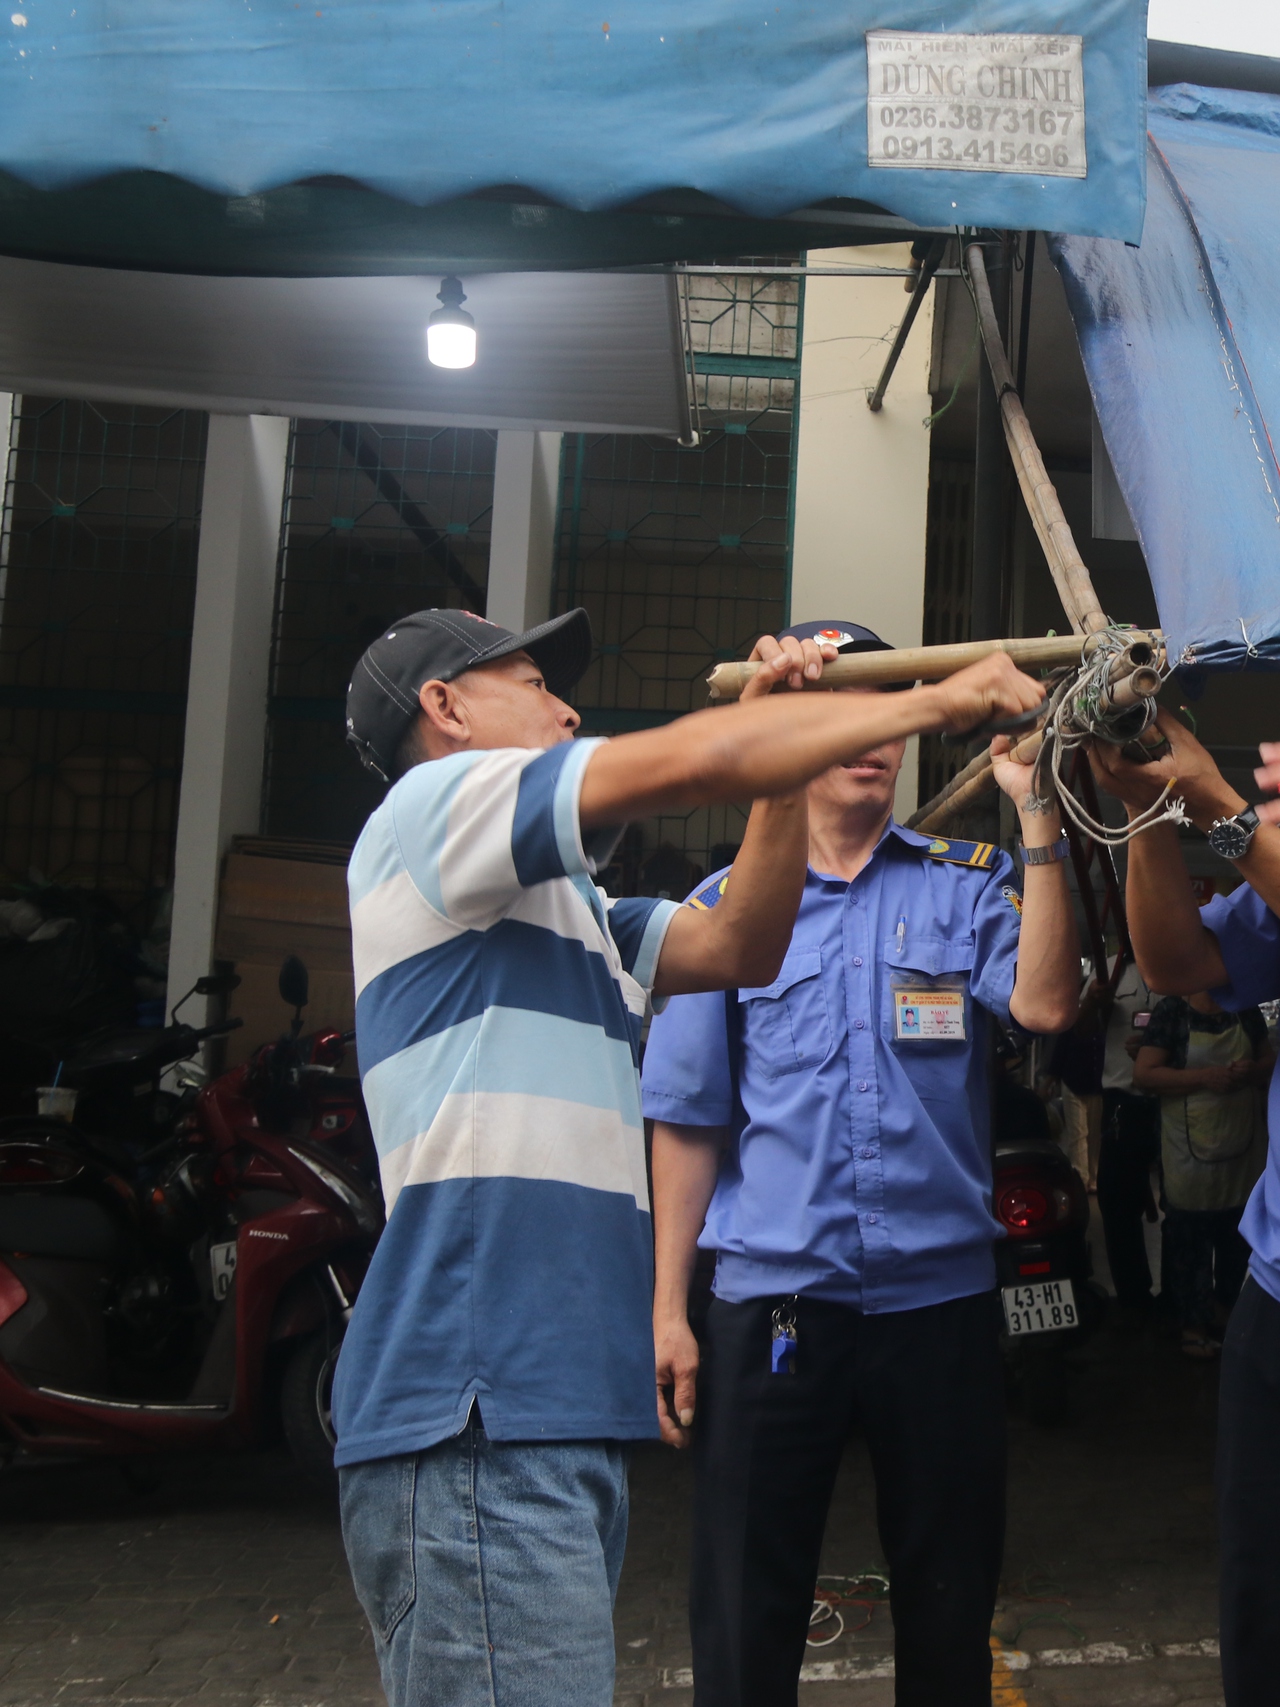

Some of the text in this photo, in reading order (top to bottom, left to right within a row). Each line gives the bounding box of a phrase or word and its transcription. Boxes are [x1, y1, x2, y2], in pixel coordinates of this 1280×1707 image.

[880, 54, 1073, 103] DŨNG CHÍNH
[880, 103, 1075, 136] 0236.3873167
[882, 135, 1069, 168] 0913.415496
[249, 1230, 290, 1240] HONDA
[1014, 1283, 1062, 1309] 43-H1
[1010, 1304, 1075, 1332] 311.89
